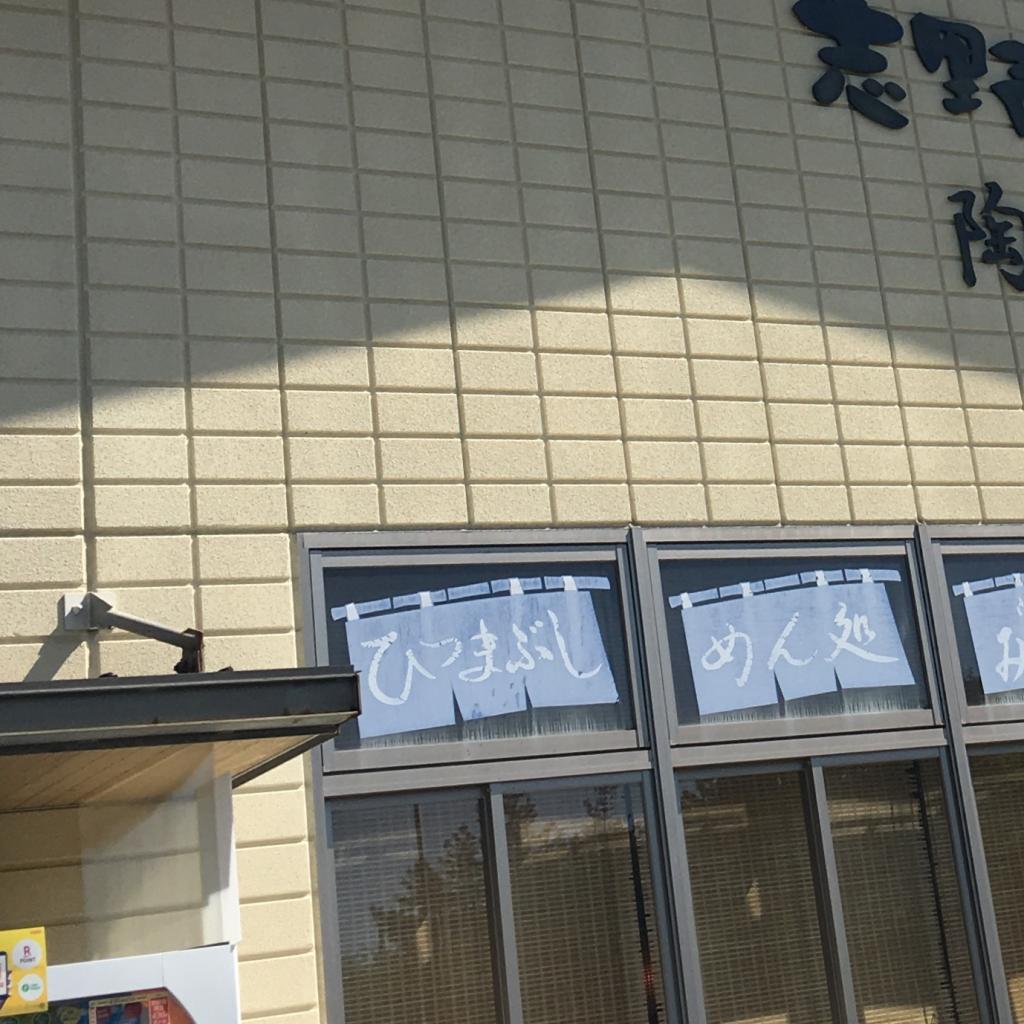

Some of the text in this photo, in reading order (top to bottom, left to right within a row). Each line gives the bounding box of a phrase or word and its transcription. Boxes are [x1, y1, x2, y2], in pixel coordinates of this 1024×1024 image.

[361, 609, 602, 706] ひつまぶし
[701, 602, 899, 687] めん処
